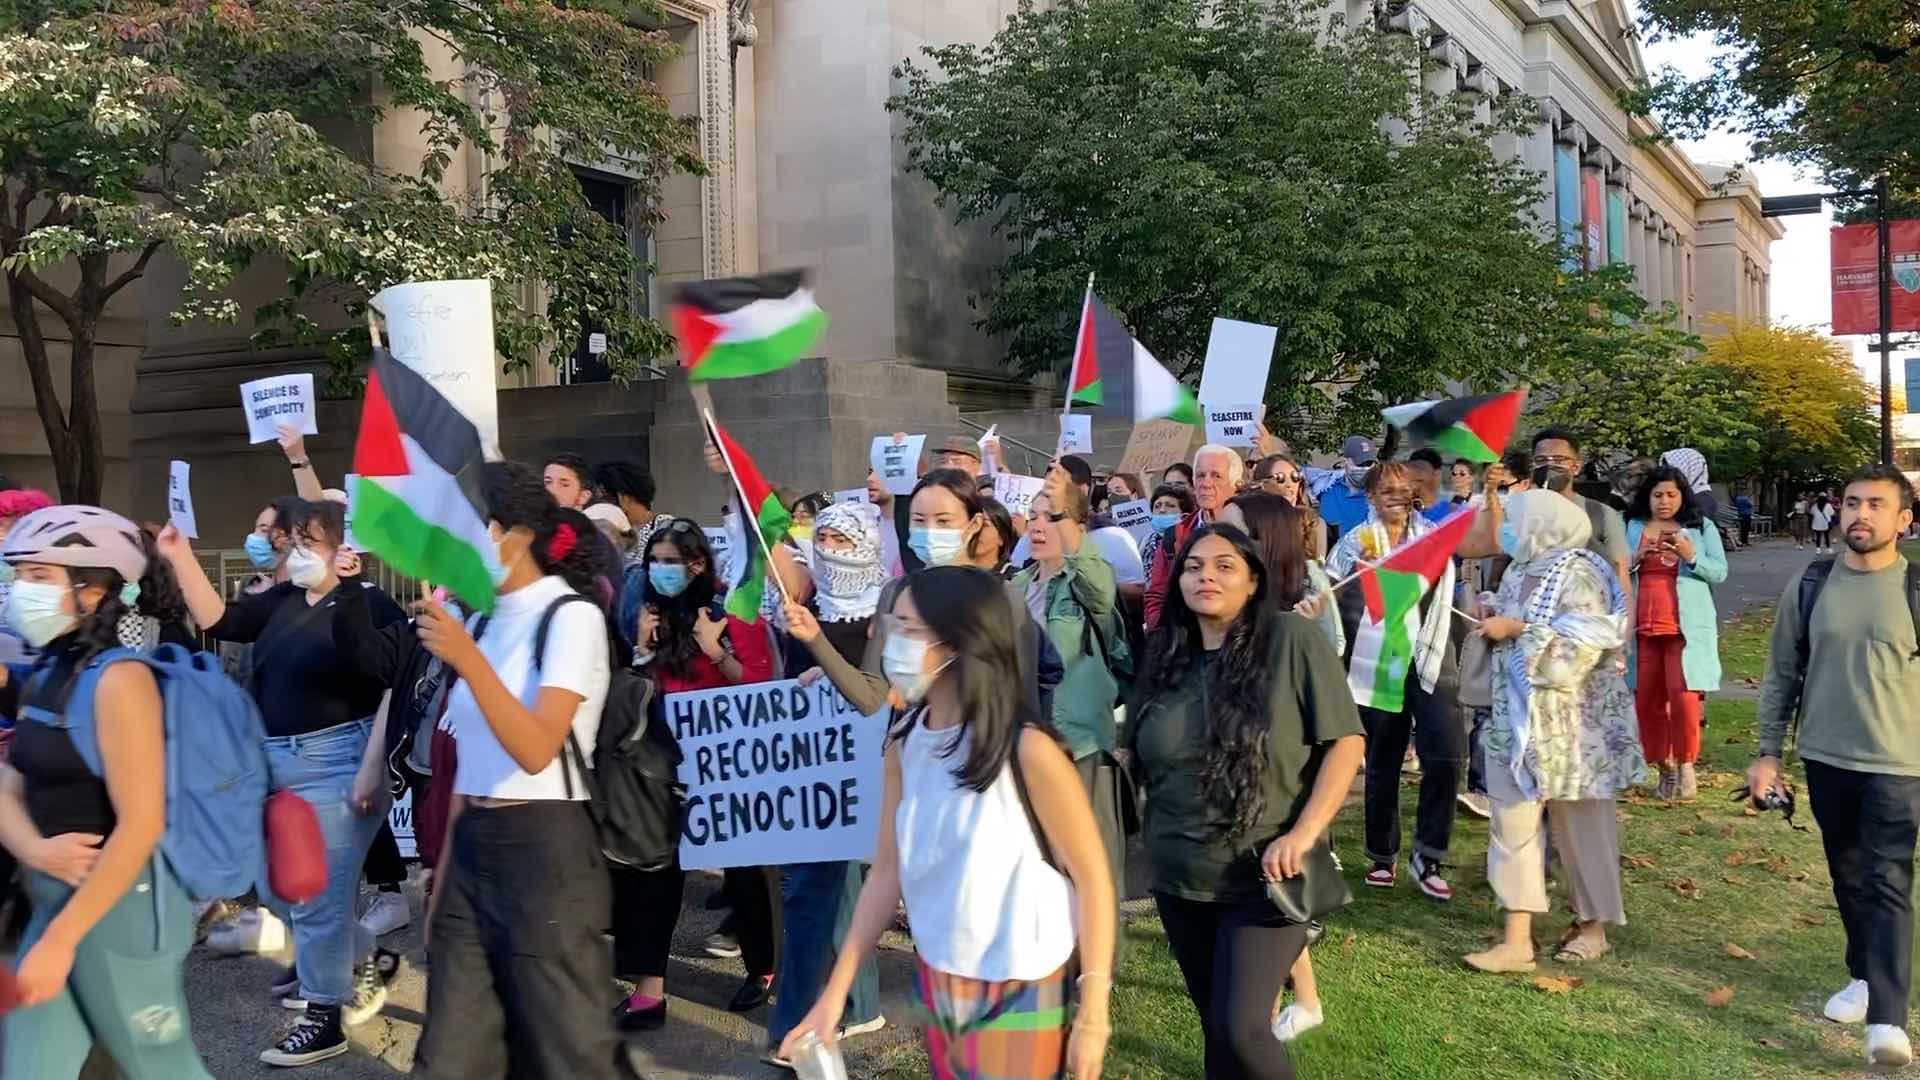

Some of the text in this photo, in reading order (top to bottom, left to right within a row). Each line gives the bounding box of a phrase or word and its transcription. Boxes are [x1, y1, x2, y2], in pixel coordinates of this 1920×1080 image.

[252, 385, 300, 402] SILENCE IS
[254, 402, 305, 420] COMPLICITY
[1211, 411, 1254, 422] CEASEFIRE
[1223, 426, 1243, 437] NOW
[674, 685, 811, 740] HARVARD
[696, 723, 856, 785] RECOGNIZE
[683, 777, 859, 846] GENOCIDE
